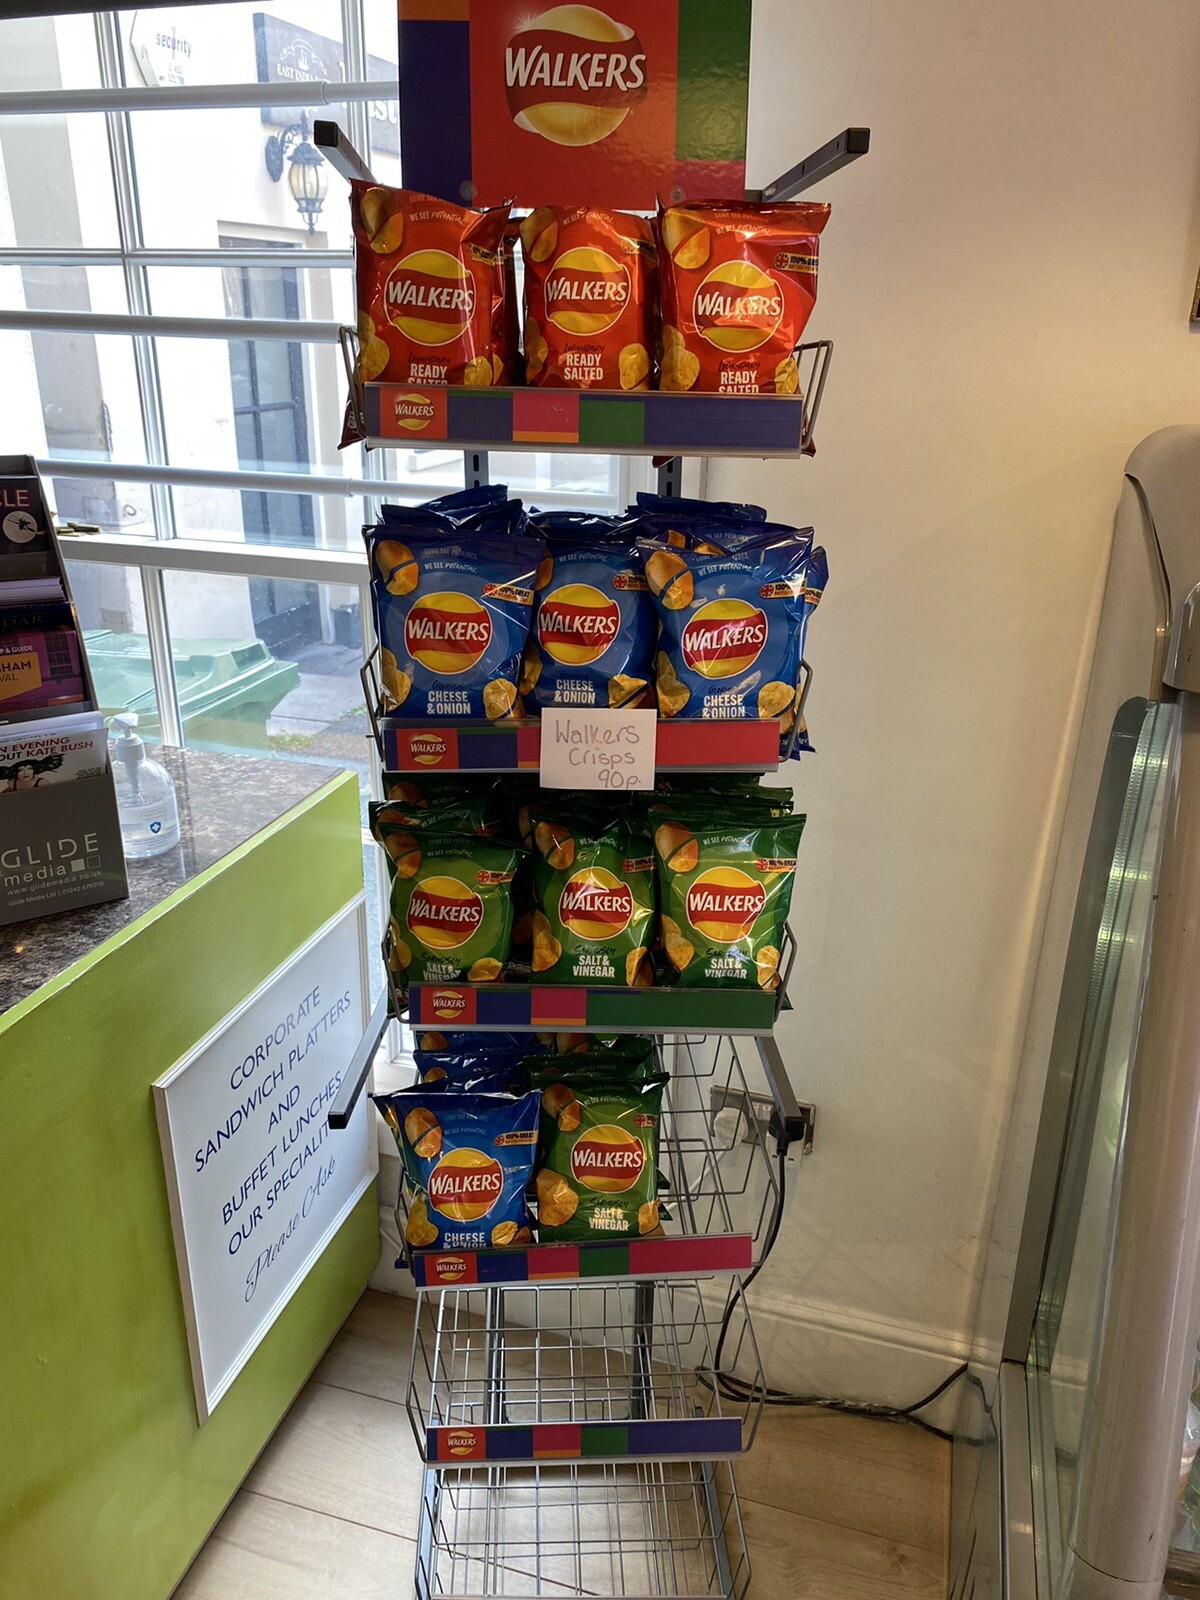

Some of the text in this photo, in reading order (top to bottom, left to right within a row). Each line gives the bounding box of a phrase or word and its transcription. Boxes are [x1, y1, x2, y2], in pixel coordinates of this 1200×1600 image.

[156, 33, 191, 58] security
[505, 45, 646, 91] WALKERS
[409, 213, 418, 222] WE
[419, 212, 430, 220] SEE
[388, 280, 474, 311] WALKERS
[547, 277, 628, 302] WALKERS
[697, 291, 781, 316] WALKERS
[566, 354, 602, 367] READY
[411, 363, 448, 379] READY
[564, 367, 604, 381] SALTED
[720, 371, 757, 385] READY
[395, 404, 435, 416] WALKERS
[0, 489, 29, 507] LE
[706, 565, 718, 574] SEE
[408, 617, 489, 642] WALKERS
[540, 611, 617, 635] WALKERS
[685, 624, 764, 652] WALKERS
[12, 645, 33, 653] GUIDE
[0, 661, 31, 673] HAM
[556, 679, 594, 691] CHEESE
[428, 691, 468, 702] CHEESE
[554, 691, 596, 704] & ONION
[703, 694, 744, 706] CHEESE
[427, 703, 471, 714] & ONION
[702, 706, 746, 718] & ONION
[556, 720, 641, 745] Walkers
[12, 737, 70, 752] EVENING
[27, 746, 57, 758] KATE
[61, 741, 94, 752] BUSH
[410, 741, 447, 753] WALKERS
[568, 748, 636, 767] Crisps
[1, 832, 99, 869] GLIDE
[4, 864, 67, 887] media
[26, 895, 45, 903] Media
[562, 891, 631, 913] WALKERS
[689, 892, 763, 912] WALKERS
[410, 898, 481, 922] WALKERS
[579, 955, 609, 966] SALT &
[711, 958, 742, 969] SALT &
[427, 963, 448, 973] SALT
[573, 966, 615, 978] VINEGAR
[704, 969, 747, 979] VINEGAR
[433, 998, 466, 1008] WALKERS
[230, 986, 321, 1090] CORPORATE
[195, 991, 351, 1173] SANDWICH PLATTERS
[268, 1085, 300, 1134] AND
[222, 1070, 342, 1226] BUFFET LUNCHES
[574, 1149, 642, 1168] WALKERS
[229, 1119, 331, 1255] OUR SPECIALIT
[431, 1173, 500, 1196] WALKERS
[594, 1207, 623, 1218] SALT &
[244, 1156, 336, 1303] Please Ask
[589, 1218, 630, 1231] VINEGAR
[444, 1232, 485, 1243] CHEESE
[436, 1263, 467, 1272] WALKERS
[447, 1438, 476, 1446] WALKERS
